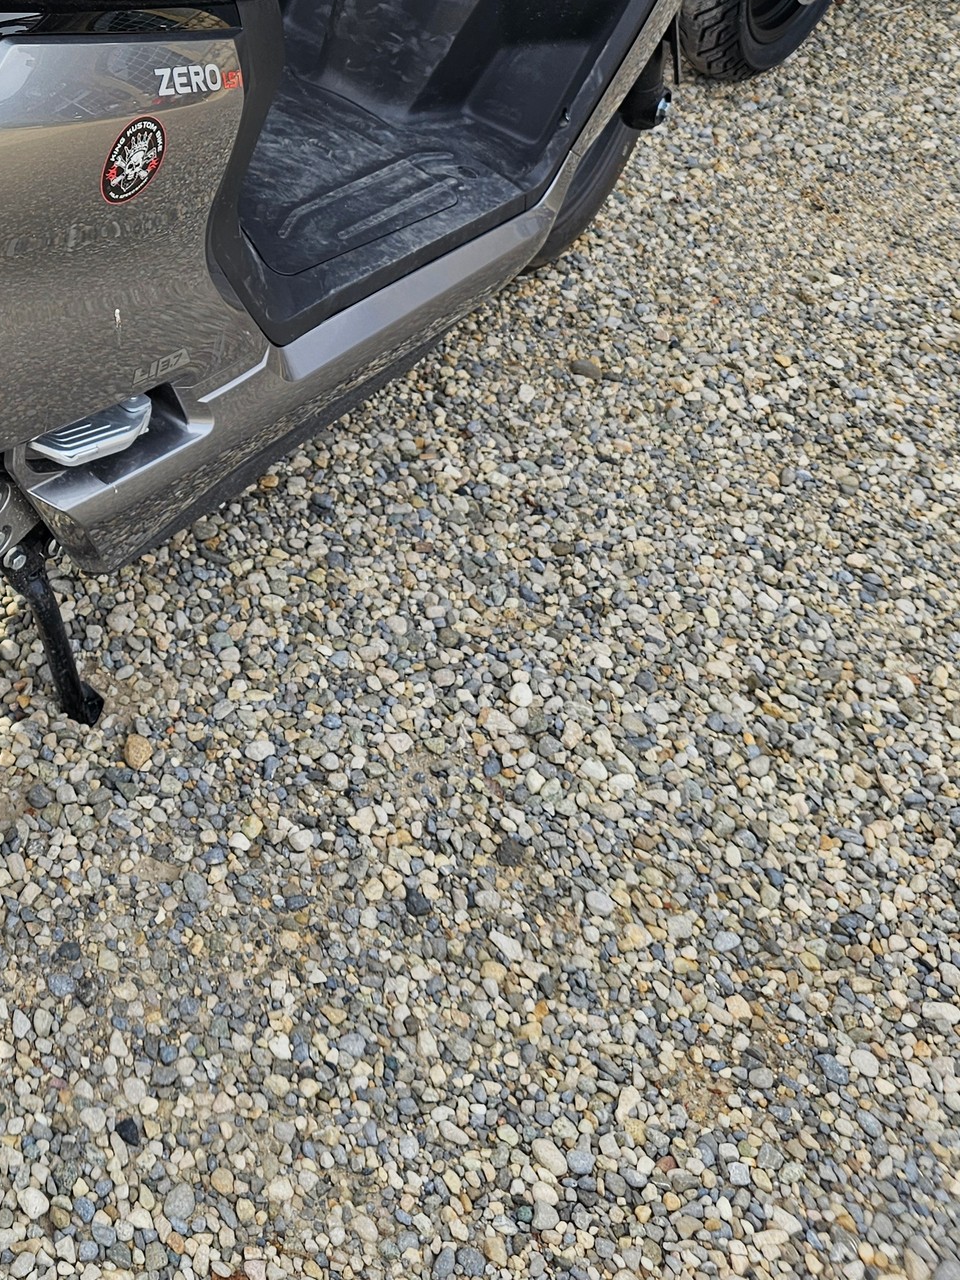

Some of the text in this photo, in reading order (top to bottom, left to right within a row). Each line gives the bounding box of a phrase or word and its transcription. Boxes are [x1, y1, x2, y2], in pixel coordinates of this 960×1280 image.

[154, 63, 221, 96] ZERO
[110, 136, 126, 162] KING
[126, 121, 158, 137] KUSTOM
